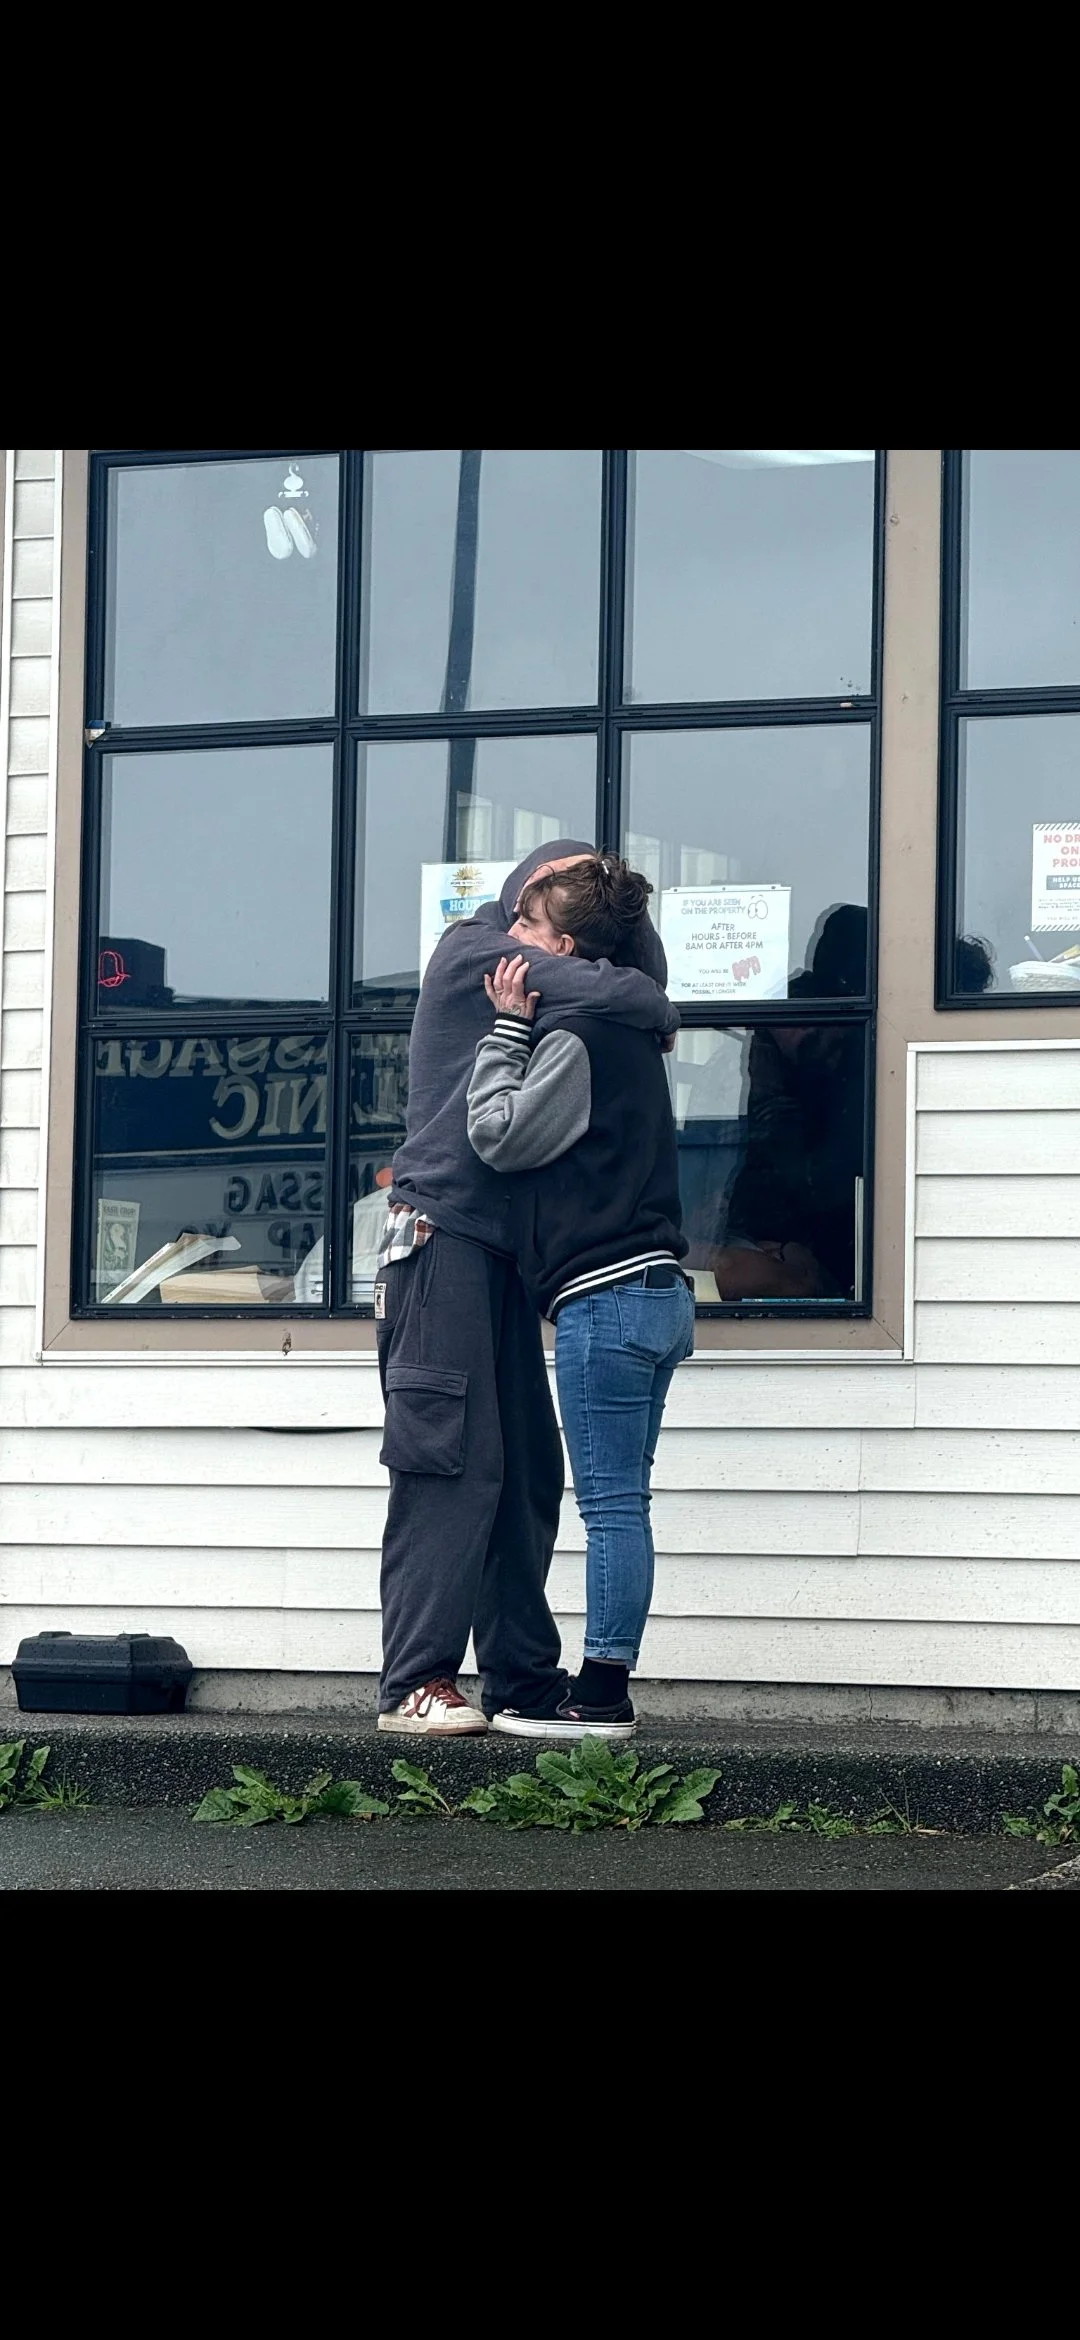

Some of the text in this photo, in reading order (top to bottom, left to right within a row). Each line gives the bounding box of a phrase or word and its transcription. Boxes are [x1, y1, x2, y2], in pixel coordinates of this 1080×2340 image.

[1043, 834, 1062, 844] NO
[1061, 846, 1079, 855] ON
[1053, 858, 1080, 868] PRO
[708, 898, 722, 906] ARE
[723, 898, 741, 906] SEEN
[681, 907, 693, 915] ON
[709, 906, 746, 914] PROPERTY
[711, 922, 735, 932] AFTER
[691, 932, 720, 941] HOURS
[727, 931, 757, 940] BEFORE
[685, 940, 764, 951] 8AM OR AFTER 4PM
